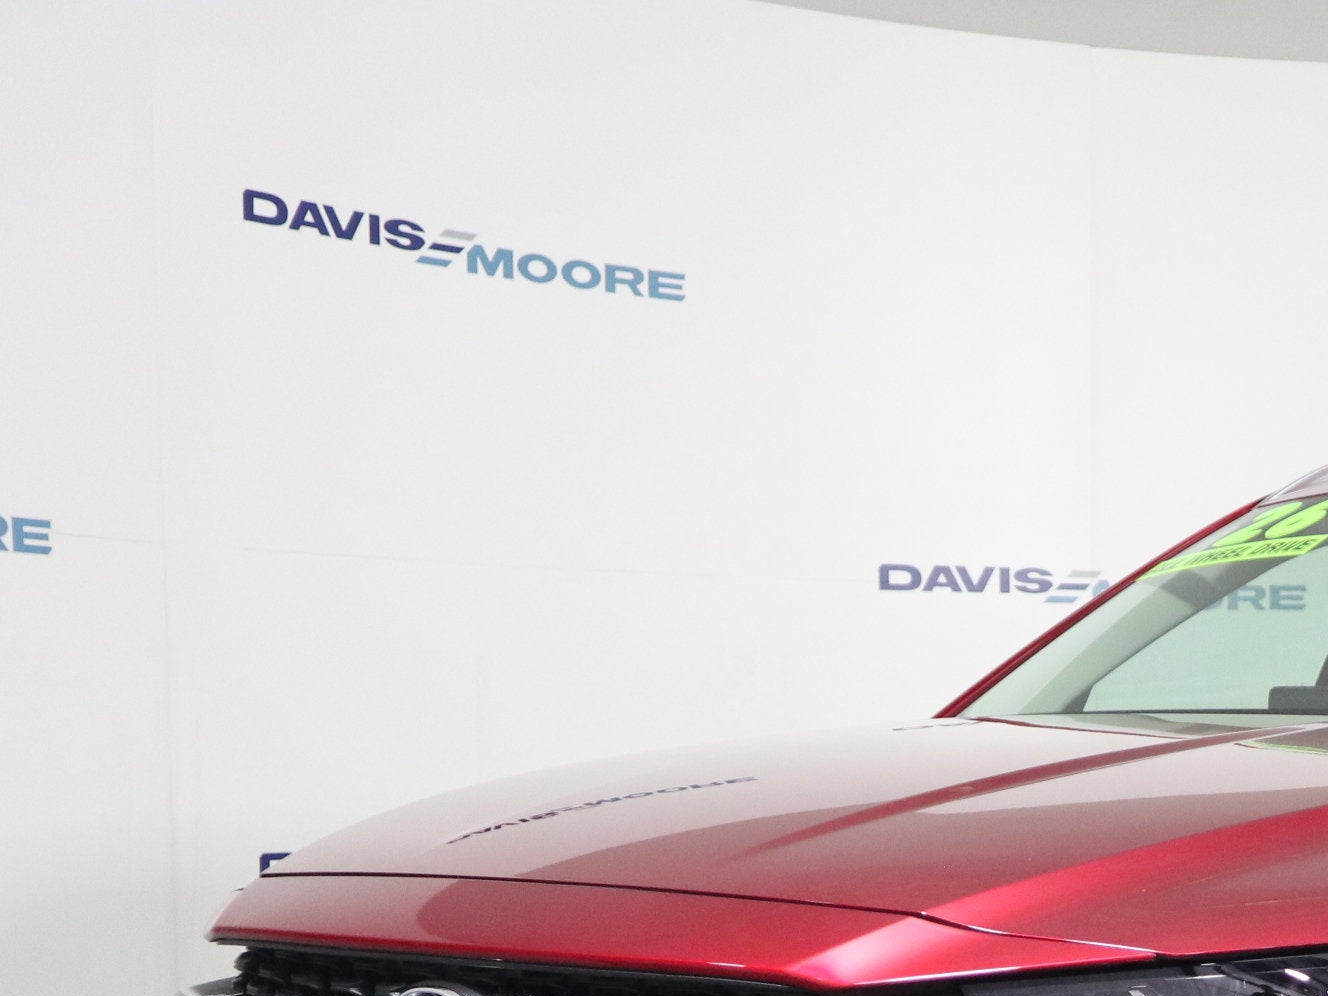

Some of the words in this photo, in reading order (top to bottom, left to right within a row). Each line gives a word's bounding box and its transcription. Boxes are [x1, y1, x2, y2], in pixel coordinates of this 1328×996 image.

[243, 189, 427, 251] DAVIS
[466, 244, 686, 301] MOORE
[1183, 546, 1252, 567] WHEEL
[1250, 538, 1318, 556] DRIVE
[878, 563, 1054, 594] DAVIS
